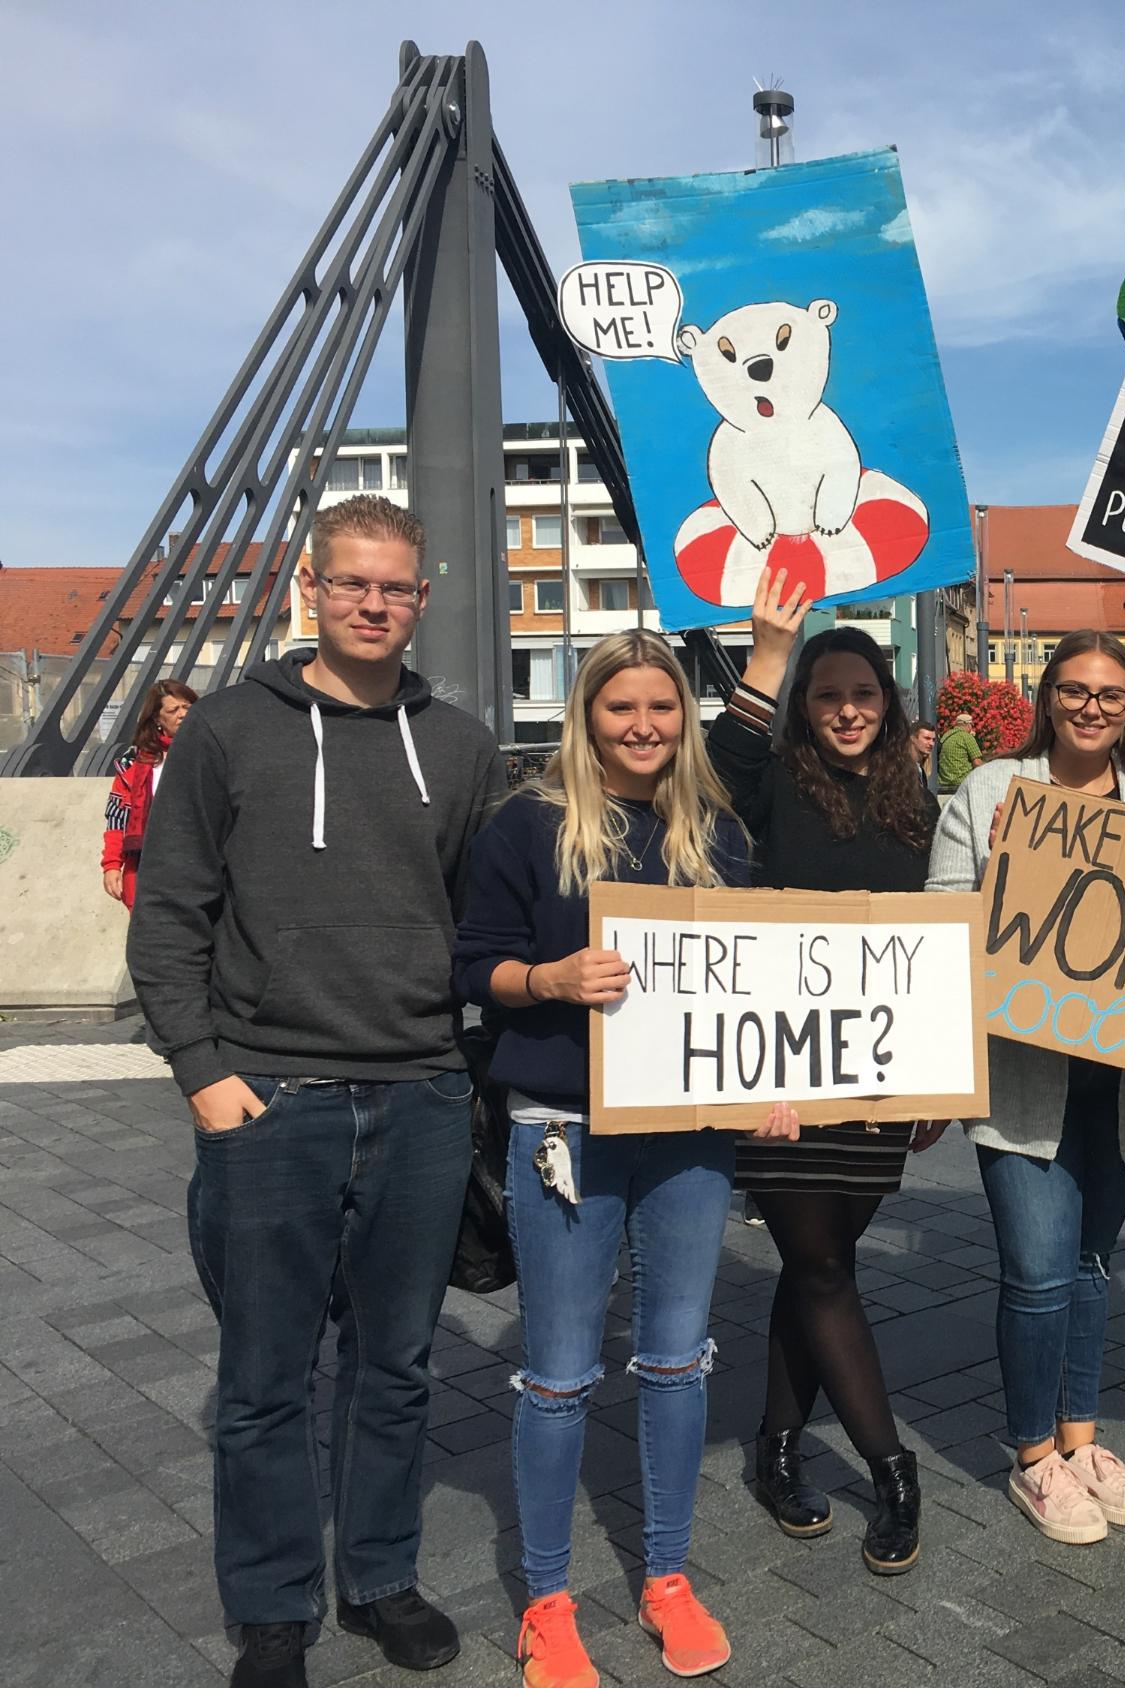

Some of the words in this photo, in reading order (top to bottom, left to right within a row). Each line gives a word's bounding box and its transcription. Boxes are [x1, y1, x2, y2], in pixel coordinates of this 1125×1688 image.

[578, 271, 665, 306] HELP
[593, 310, 655, 349] ME!
[861, 934, 925, 997] MY
[683, 1004, 895, 1093] HOME?
